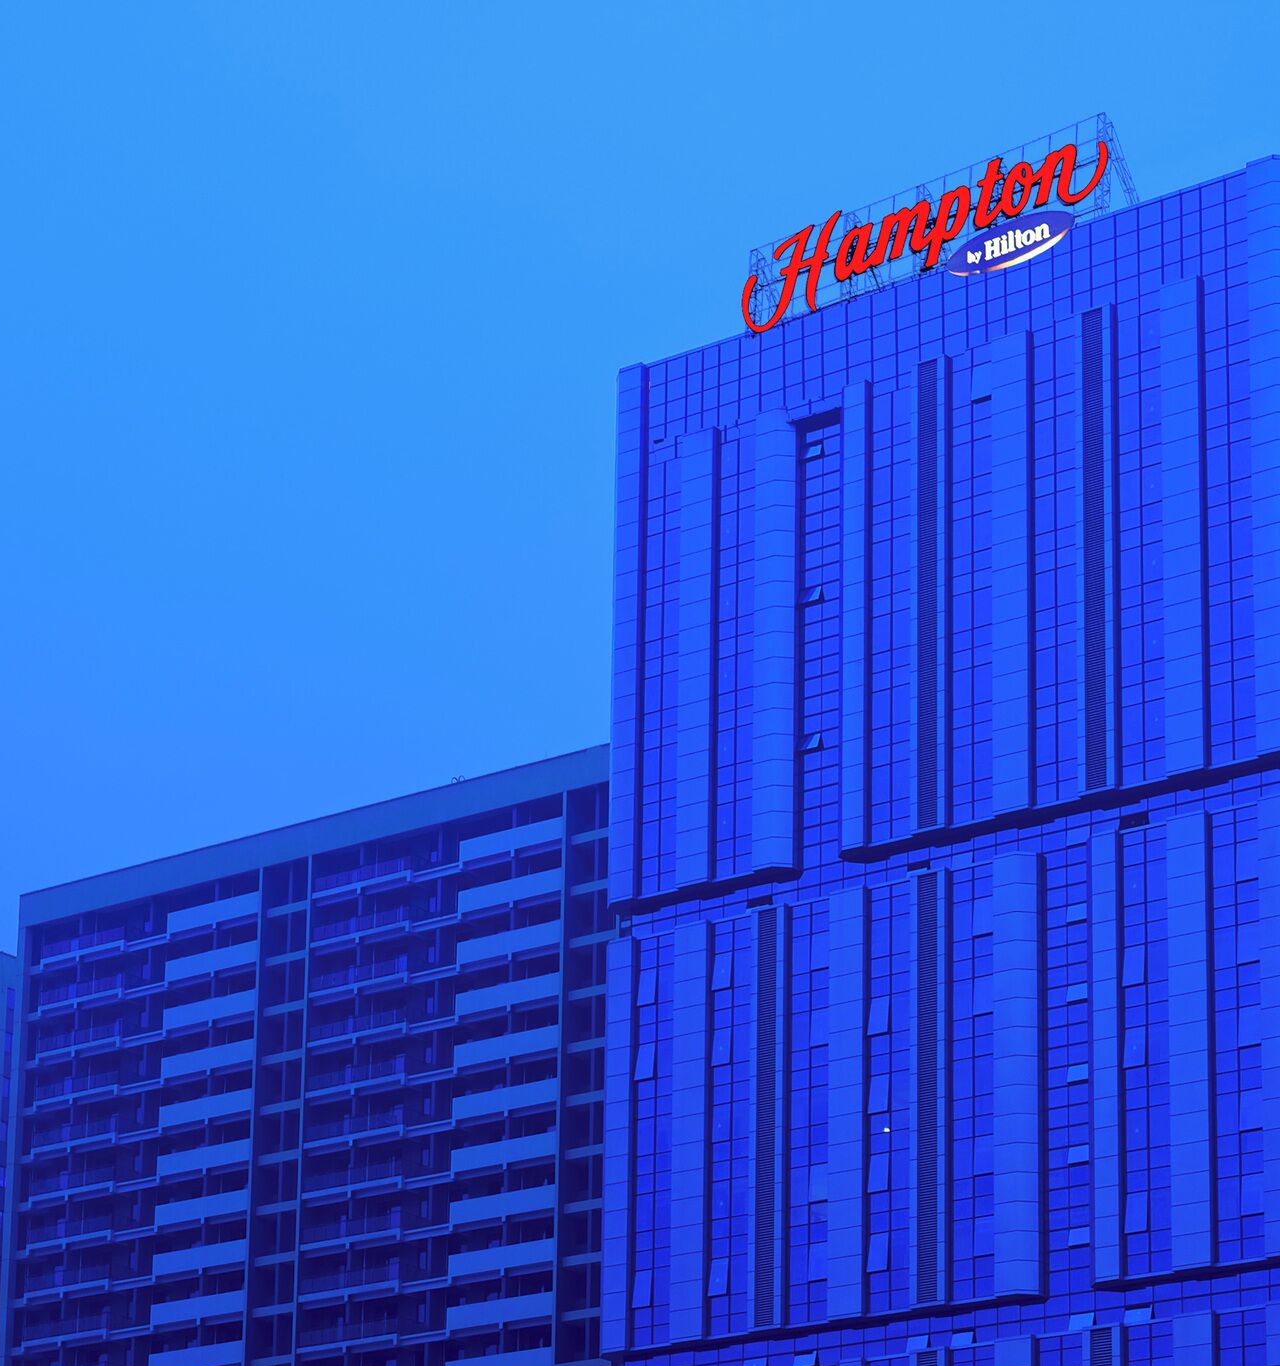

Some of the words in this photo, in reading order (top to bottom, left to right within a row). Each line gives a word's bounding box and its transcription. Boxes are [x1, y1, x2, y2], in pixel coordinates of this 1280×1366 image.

[742, 141, 1108, 333] Hampton
[966, 249, 983, 265] by
[984, 221, 1051, 261] Hilton
